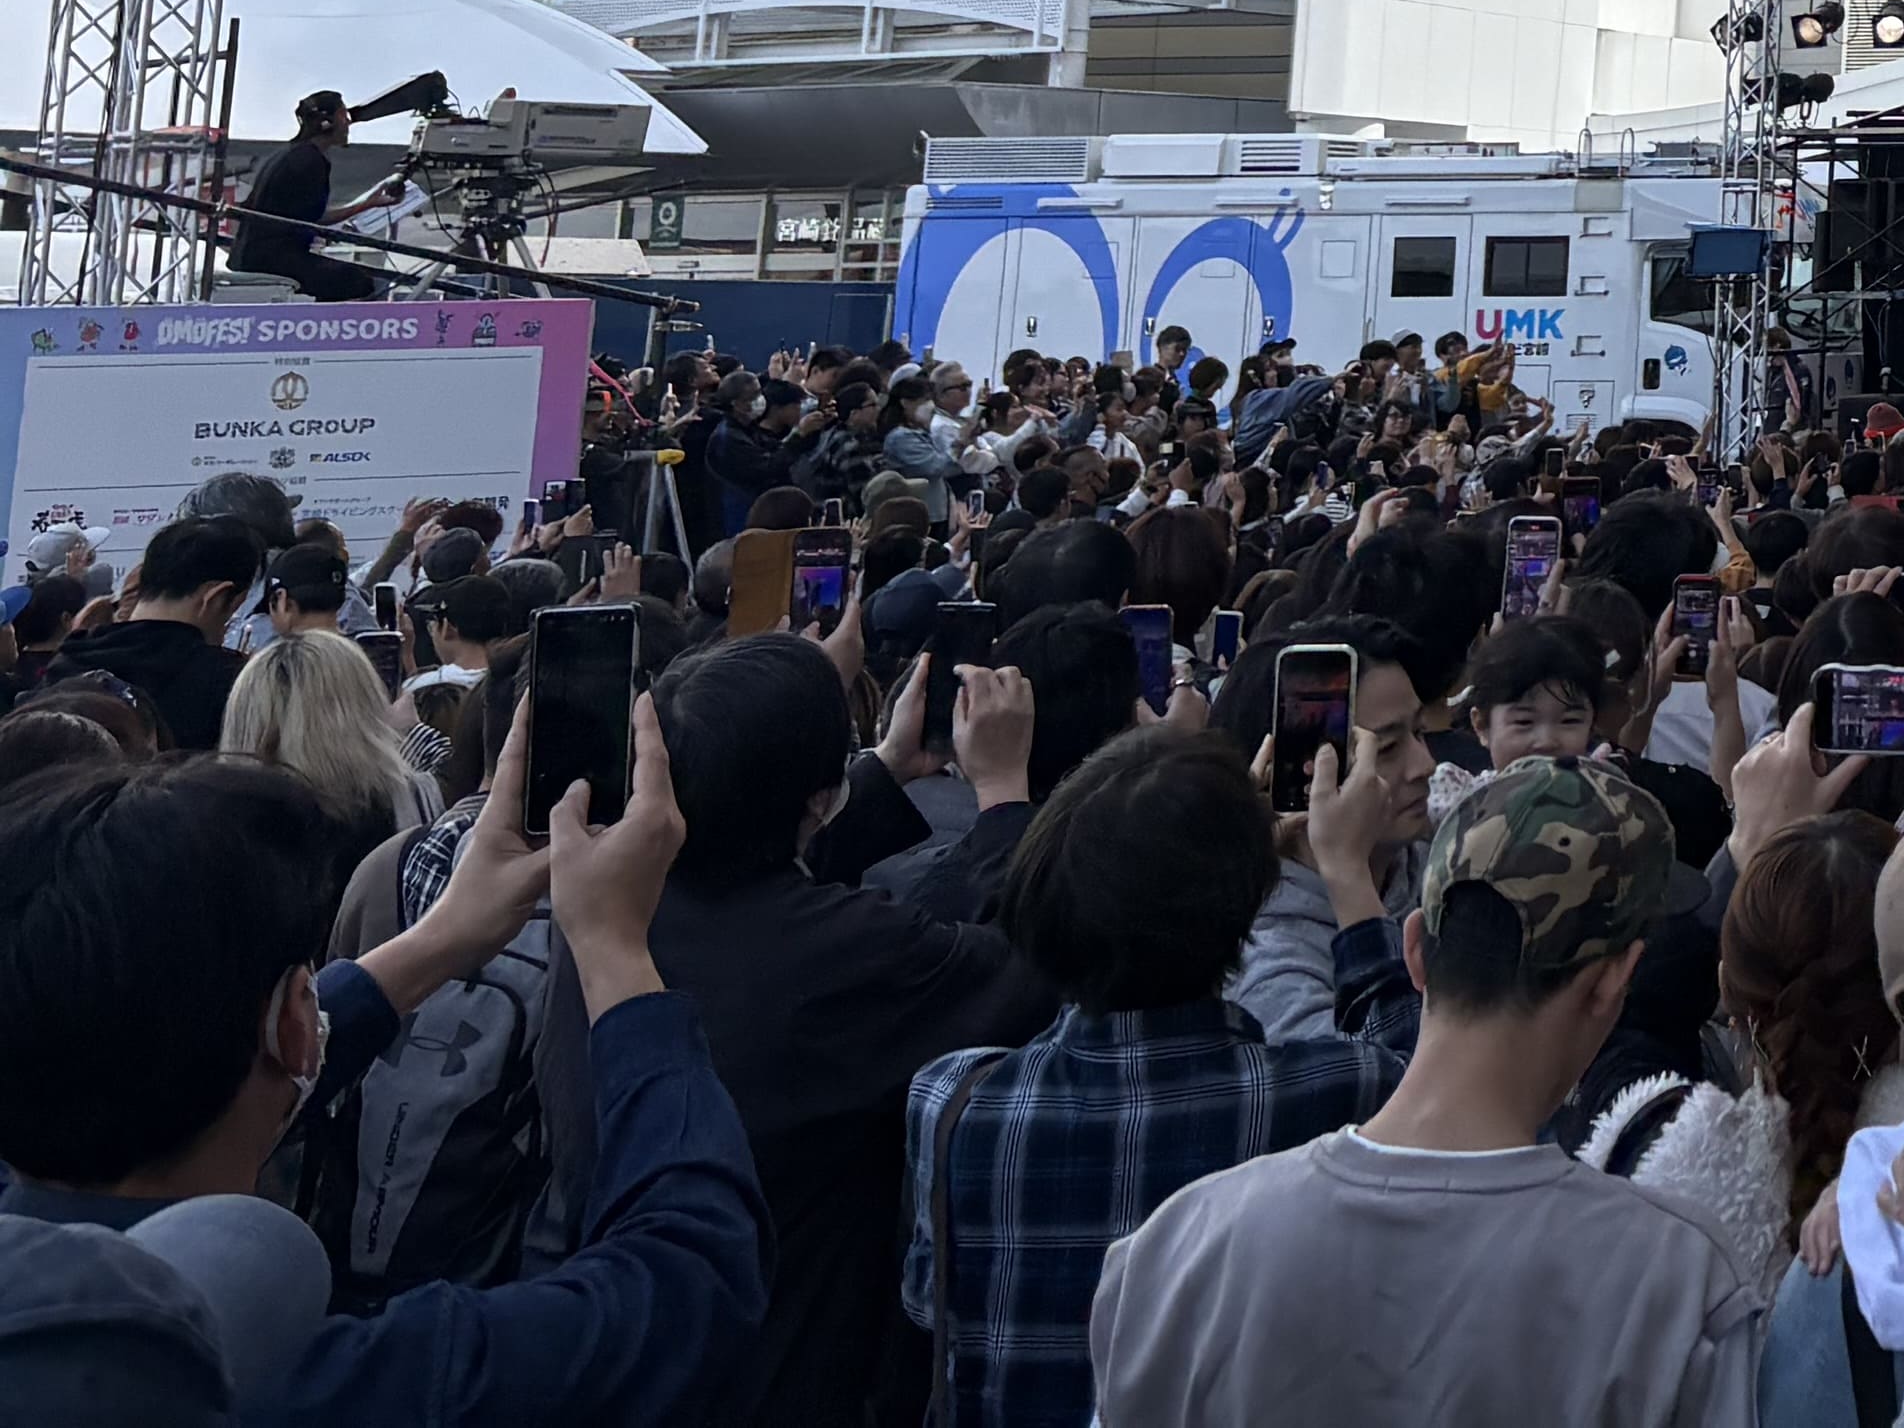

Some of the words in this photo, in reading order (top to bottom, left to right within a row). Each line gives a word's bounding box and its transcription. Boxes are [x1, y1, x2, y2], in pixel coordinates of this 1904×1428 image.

[257, 317, 419, 342] SPONSORS
[1476, 309, 1566, 340] UMK
[194, 419, 284, 439] BUNKA
[289, 417, 375, 436] GROUP
[323, 451, 371, 463] ALSOK
